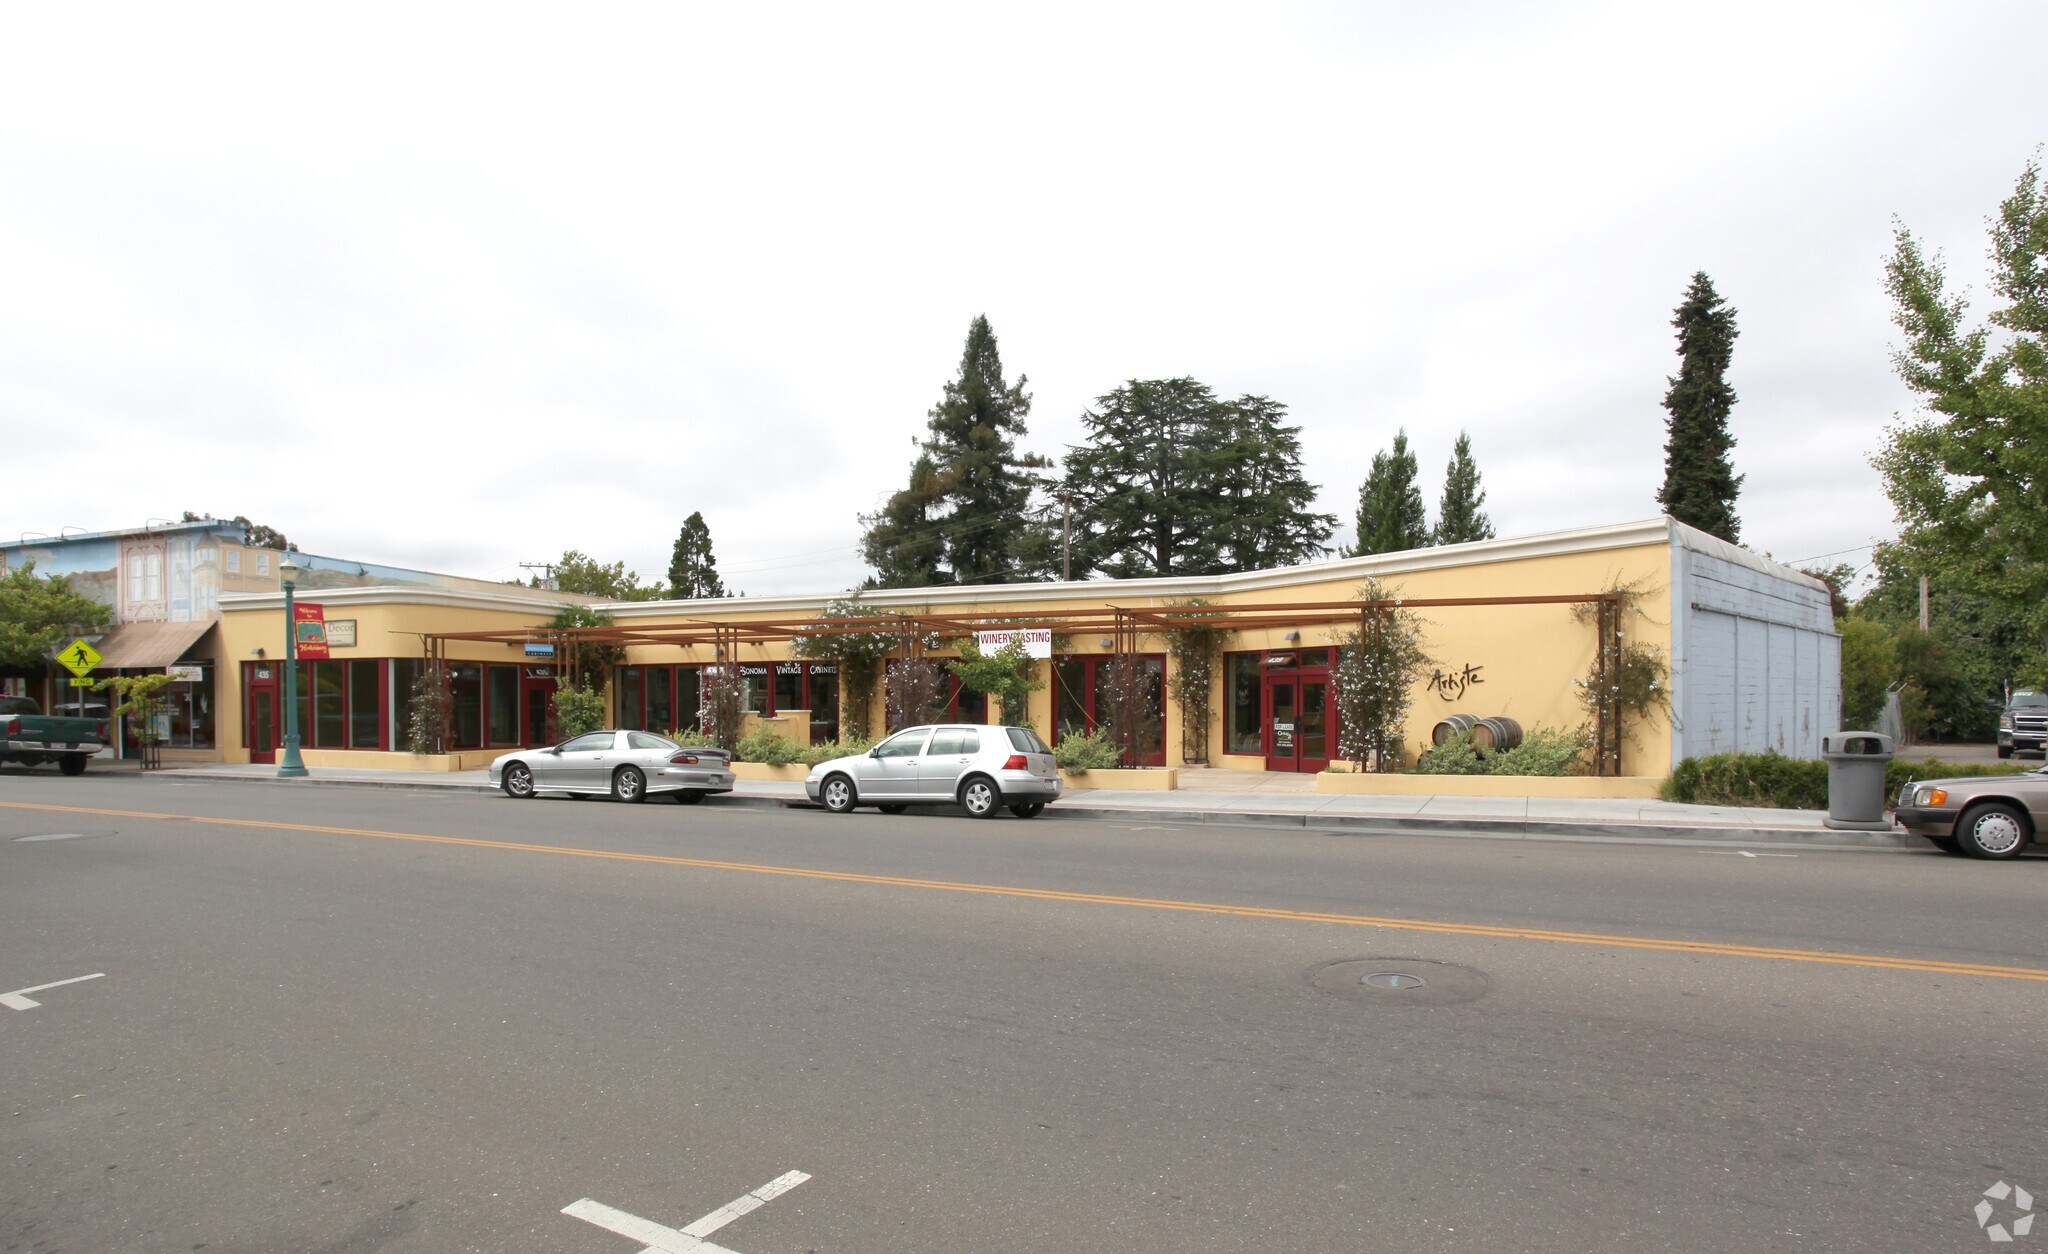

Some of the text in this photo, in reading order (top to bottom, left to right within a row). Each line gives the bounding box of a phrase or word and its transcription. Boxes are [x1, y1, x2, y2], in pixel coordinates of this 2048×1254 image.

[328, 622, 355, 633] Decor
[980, 631, 1051, 645] WINERY ASTING
[258, 670, 270, 679] 435
[741, 664, 837, 676] SONOMA VINTAGE CABINETS
[1426, 662, 1485, 702] Artiste
